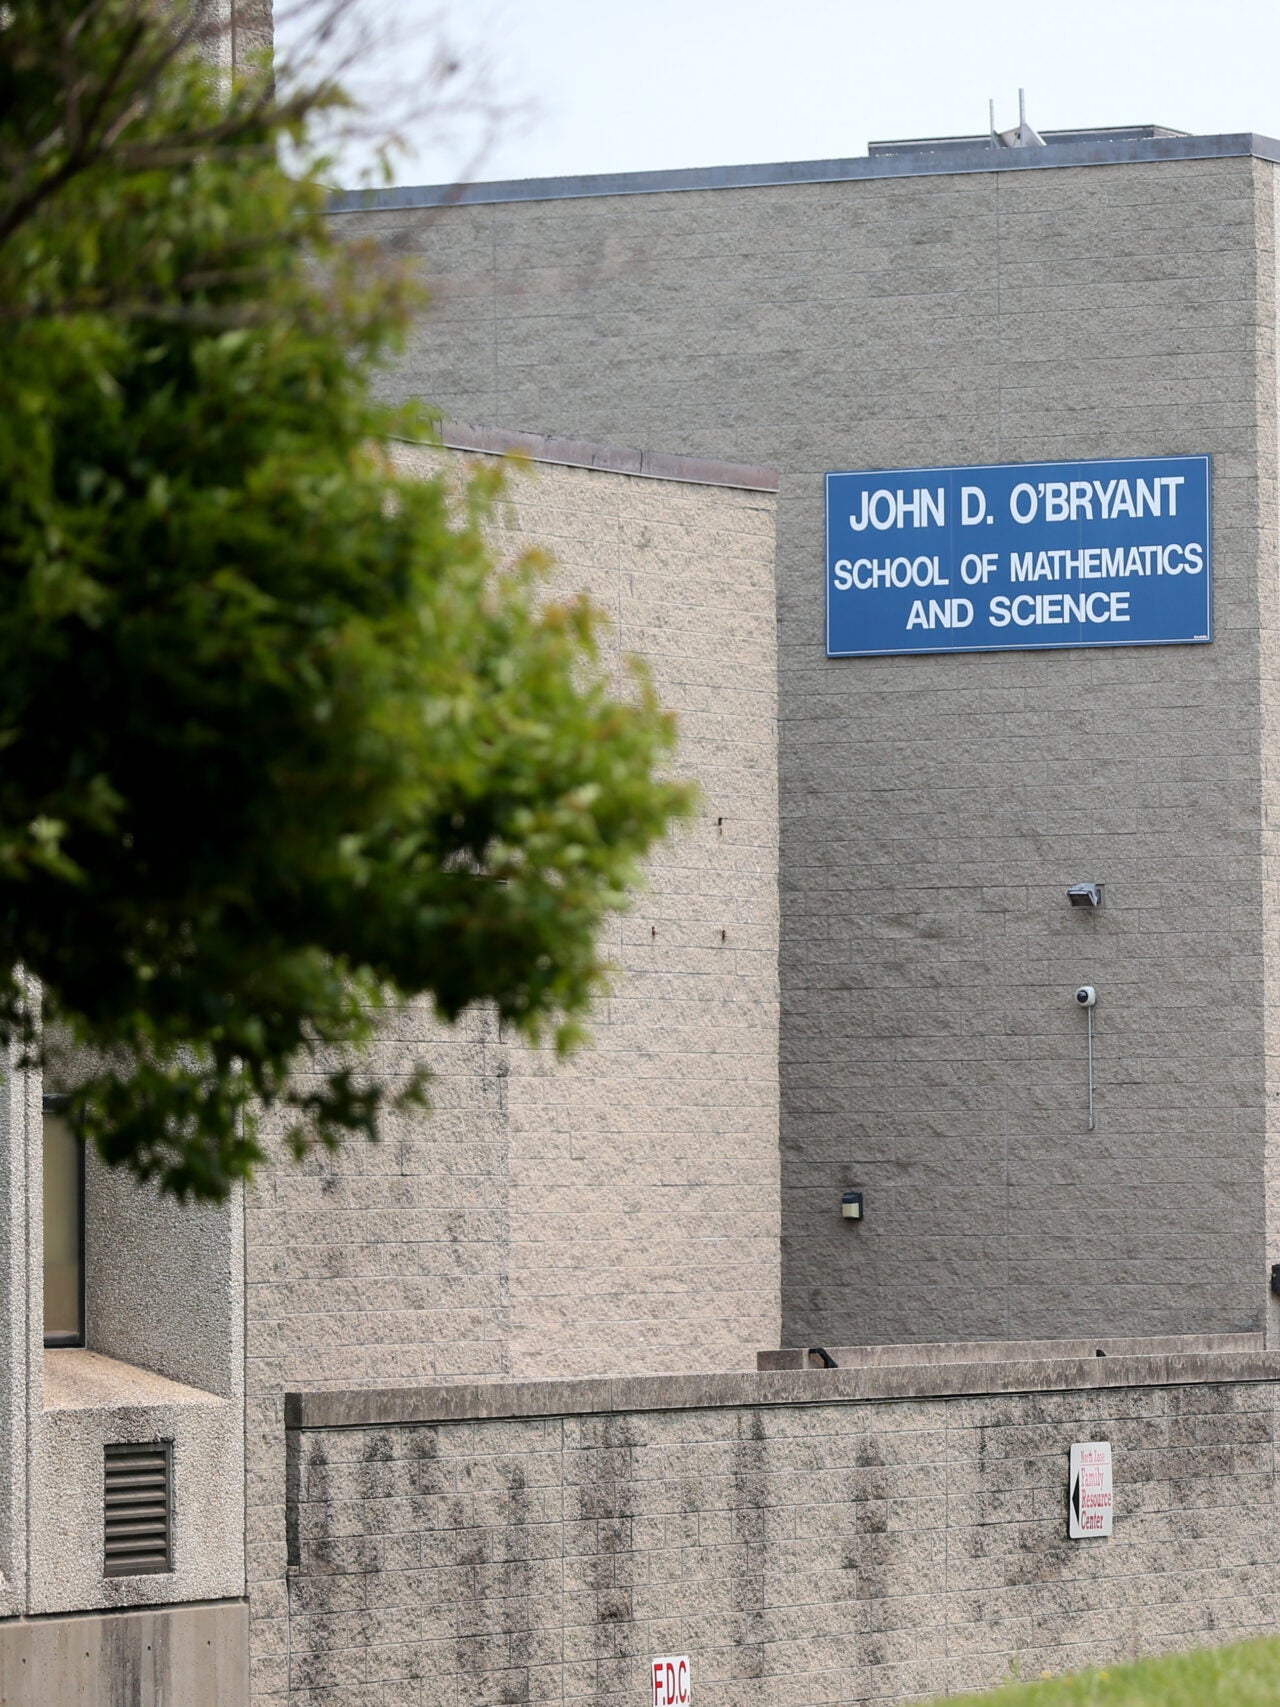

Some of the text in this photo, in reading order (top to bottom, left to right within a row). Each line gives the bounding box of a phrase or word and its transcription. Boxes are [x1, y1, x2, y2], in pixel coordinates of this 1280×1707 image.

[849, 476, 1185, 532] JOHN D. O'BRYANT
[834, 542, 1203, 591] SCHOOL OF MATHEMATICS
[905, 591, 1131, 630] AND SCIENCE
[1081, 1467, 1104, 1491] Family
[1081, 1489, 1112, 1509] Resource
[1081, 1510, 1104, 1530] Center
[653, 1660, 690, 1706] F.D.C.
